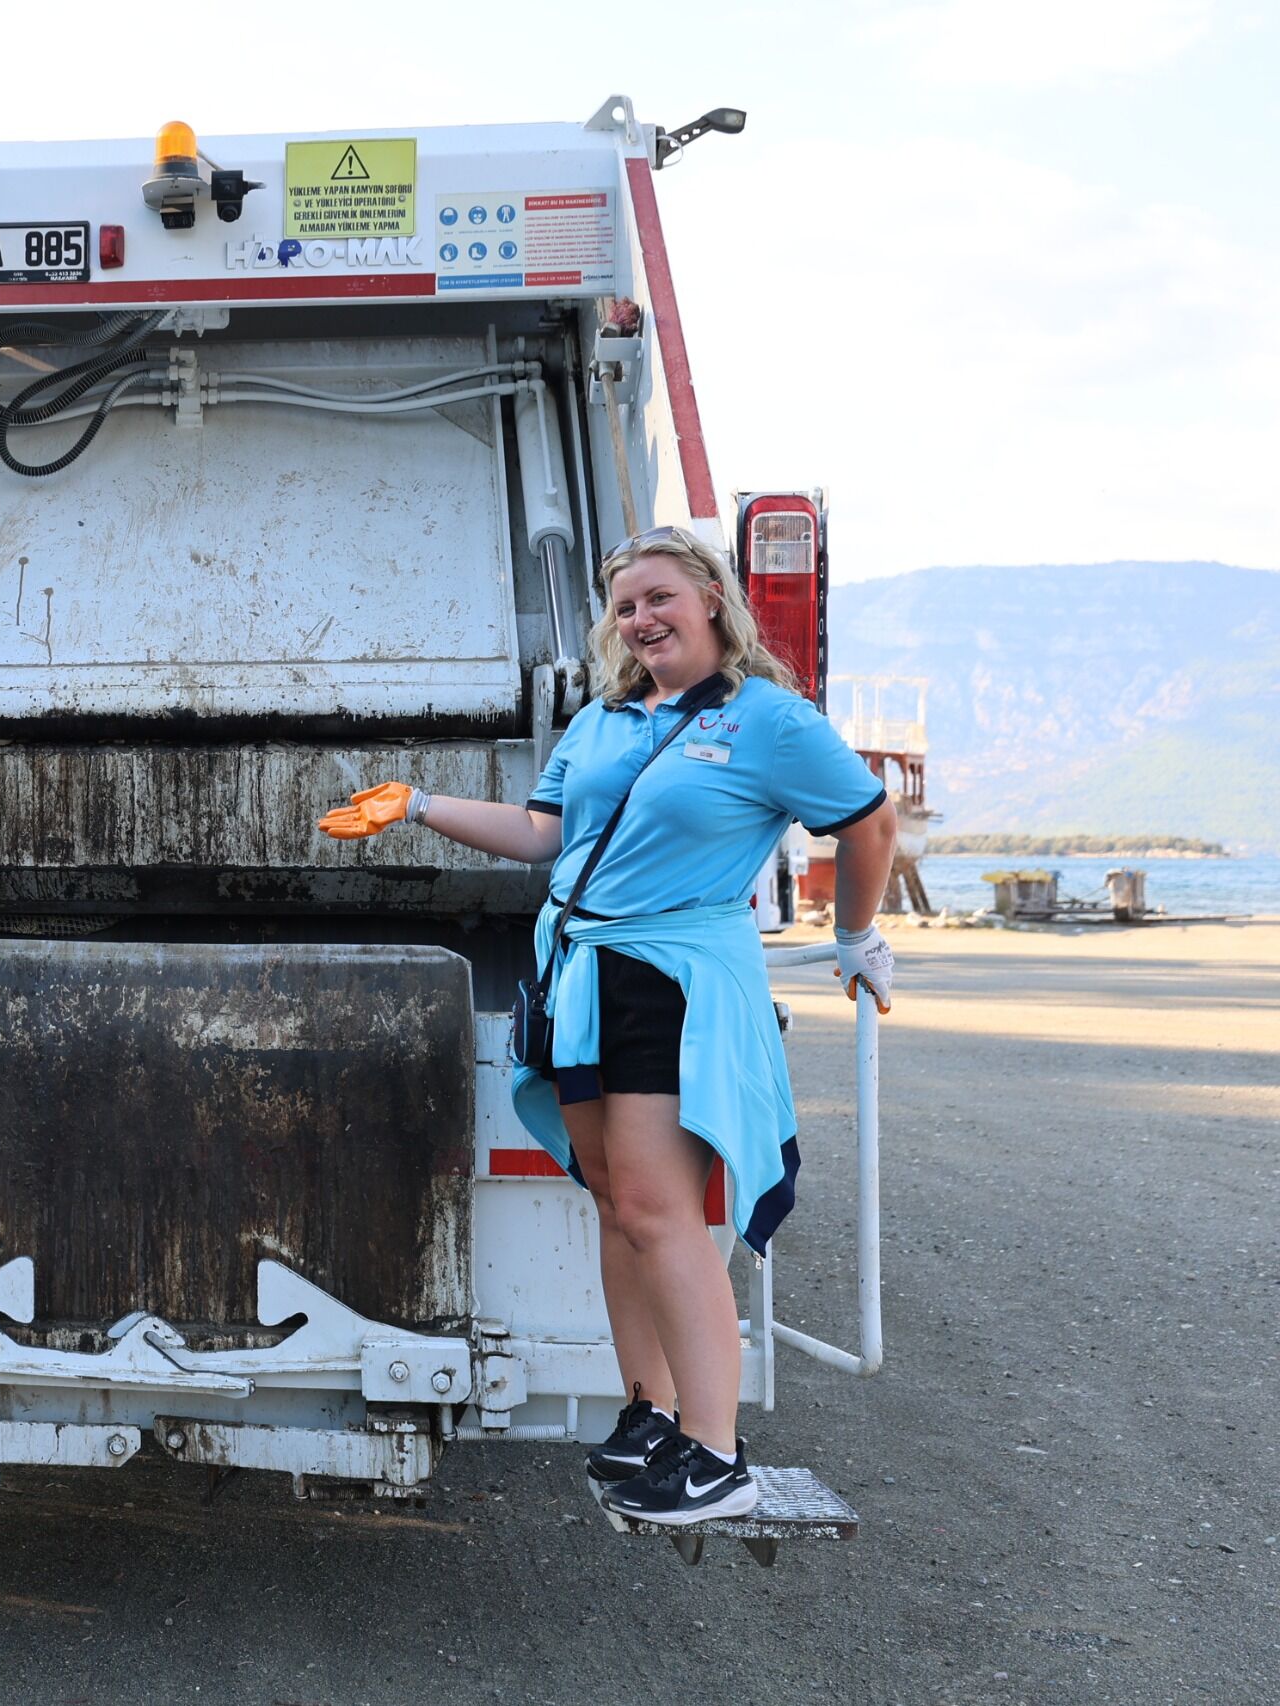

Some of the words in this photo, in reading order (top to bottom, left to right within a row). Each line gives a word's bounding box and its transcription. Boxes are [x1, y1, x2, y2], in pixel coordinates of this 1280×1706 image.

[288, 186, 321, 196] YÜKLEME
[324, 186, 349, 195] YAPAN
[351, 185, 383, 194] KAMYON
[384, 184, 412, 194] ŞOFÖRÜ
[304, 199, 313, 208] VE
[316, 198, 352, 207] YÜKLEYİCİ
[354, 197, 395, 207] OPERATÖRÜ
[294, 210, 322, 220] GEREKLİ
[324, 209, 357, 220] GÜVENLİK
[360, 208, 406, 218] ÖNLEMLERİNİ
[300, 223, 335, 232] ALMADAN
[338, 222, 371, 231] YÜKLEME
[373, 222, 400, 230] YAPMA
[24, 230, 82, 267] 885
[722, 722, 740, 732] TUI
